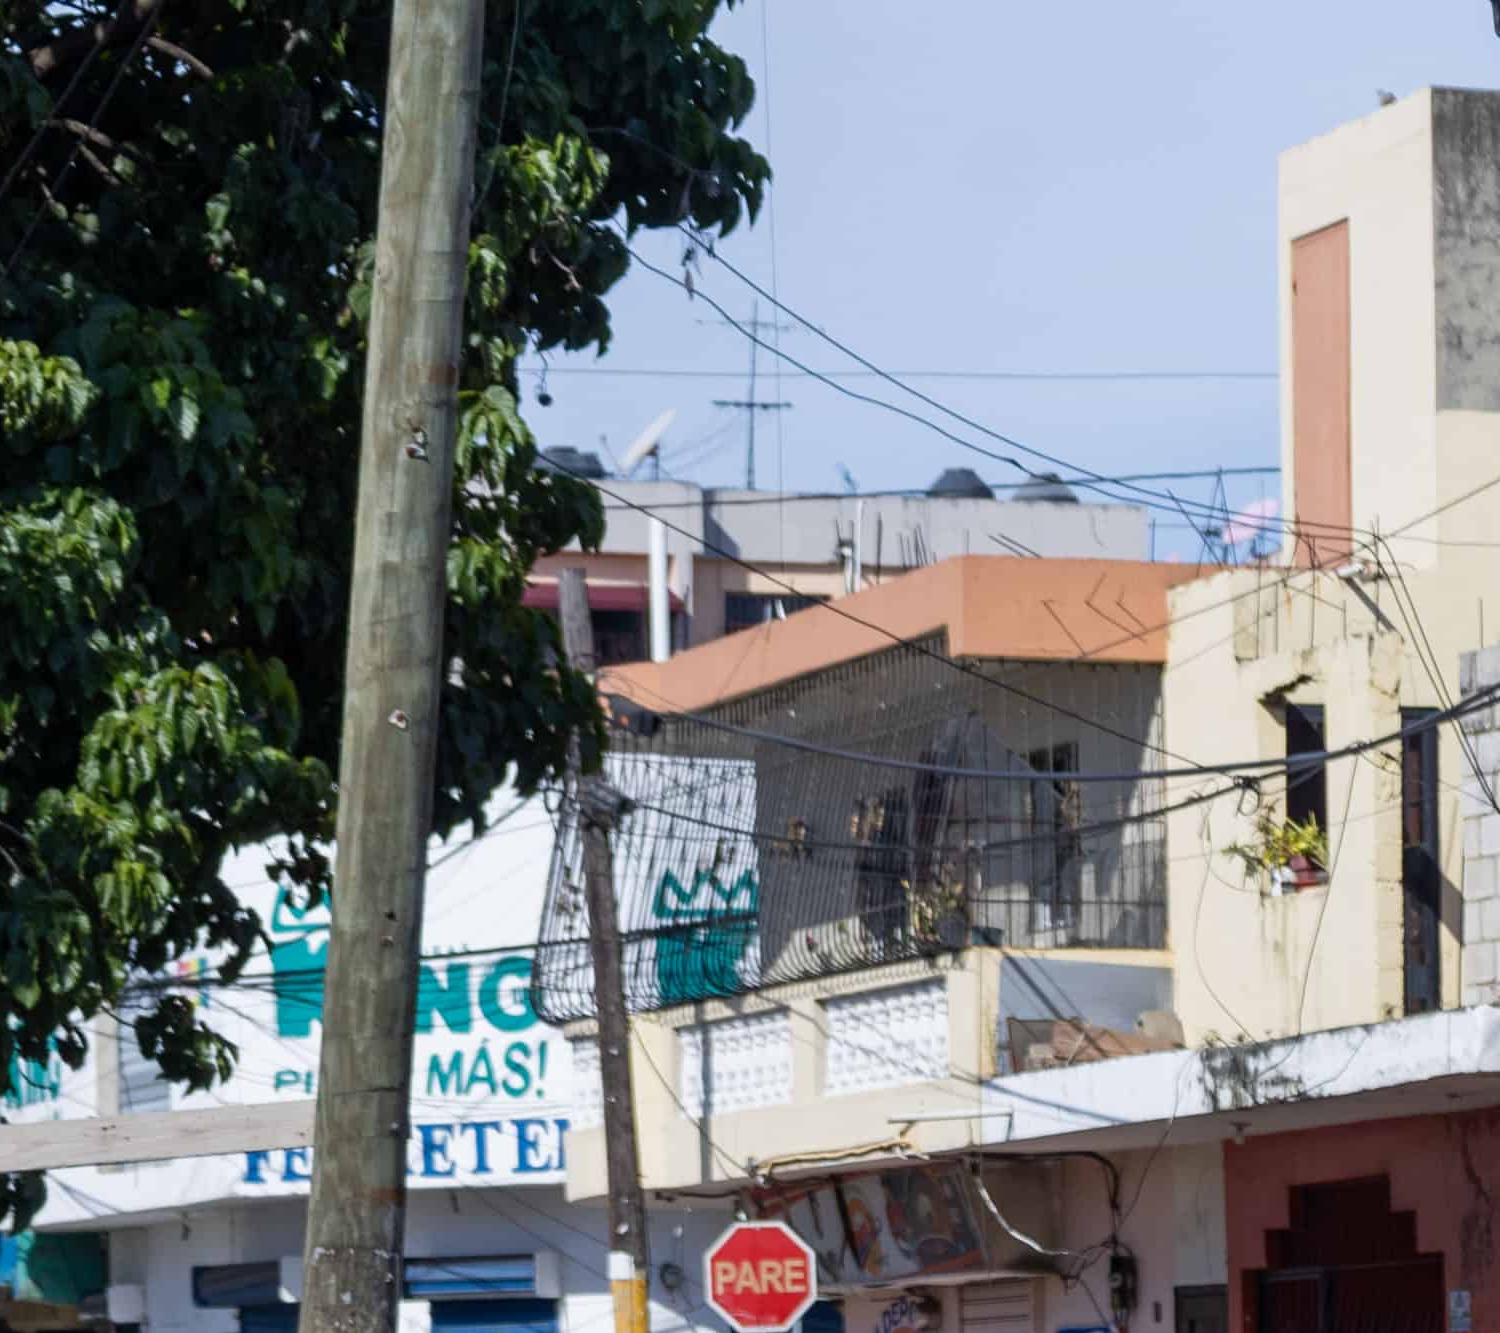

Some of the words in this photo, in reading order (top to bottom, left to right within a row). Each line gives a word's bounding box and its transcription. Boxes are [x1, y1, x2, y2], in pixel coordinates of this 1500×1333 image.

[271, 937, 547, 1038] KNG
[427, 1038, 549, 1098] MÁS!
[715, 1259, 806, 1296] PARE
